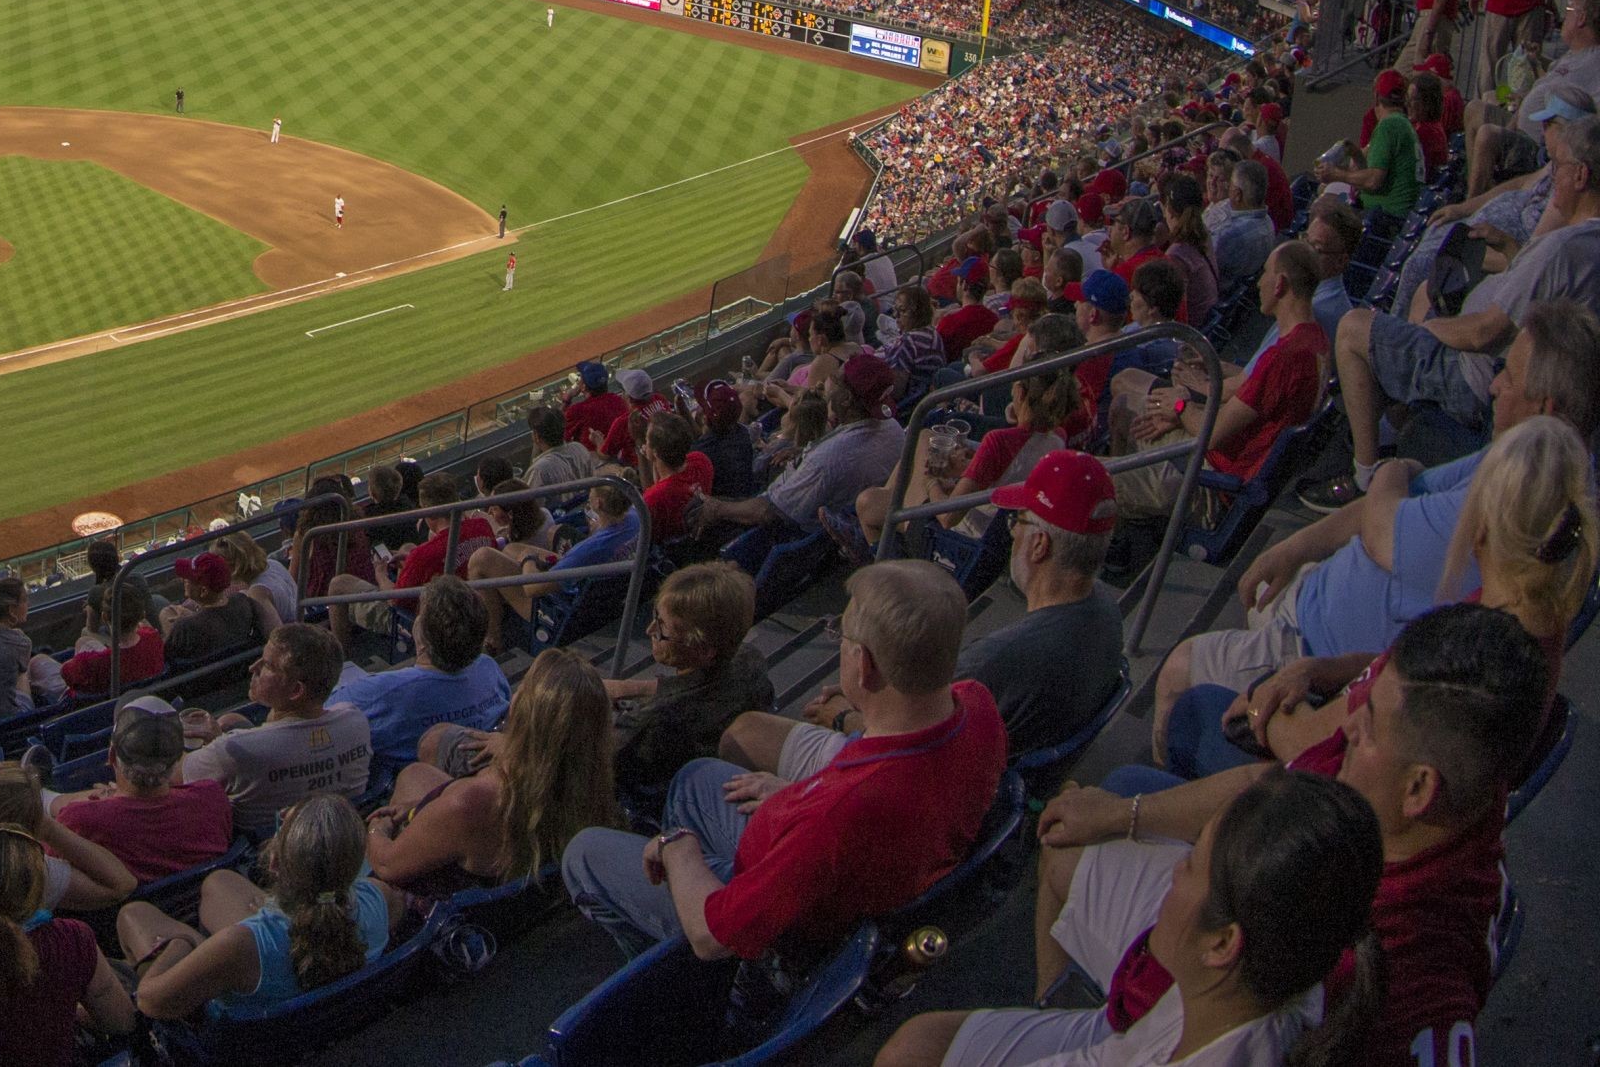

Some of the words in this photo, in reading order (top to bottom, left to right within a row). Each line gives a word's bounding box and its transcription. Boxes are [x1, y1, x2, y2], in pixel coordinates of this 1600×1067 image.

[268, 757, 335, 783] OPENING
[338, 743, 369, 766] WEEK
[308, 771, 342, 791] 2011
